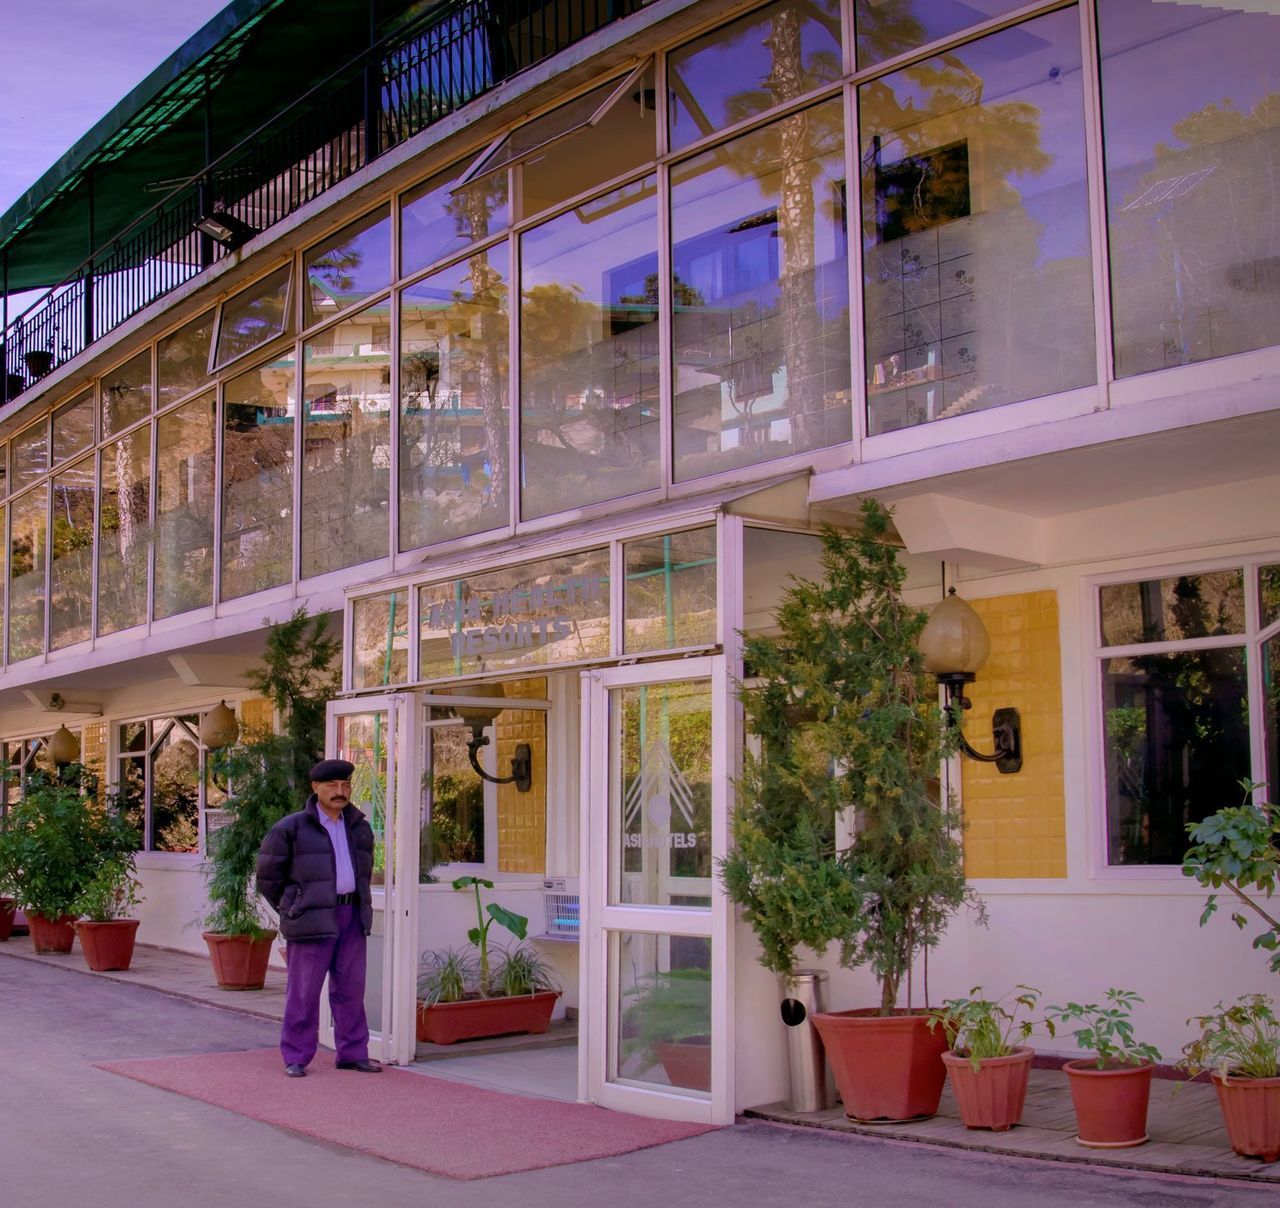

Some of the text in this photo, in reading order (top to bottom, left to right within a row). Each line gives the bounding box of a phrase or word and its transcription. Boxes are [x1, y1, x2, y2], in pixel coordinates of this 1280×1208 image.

[429, 574, 602, 629] ASIA HEALTH
[451, 616, 572, 657] RESORTS
